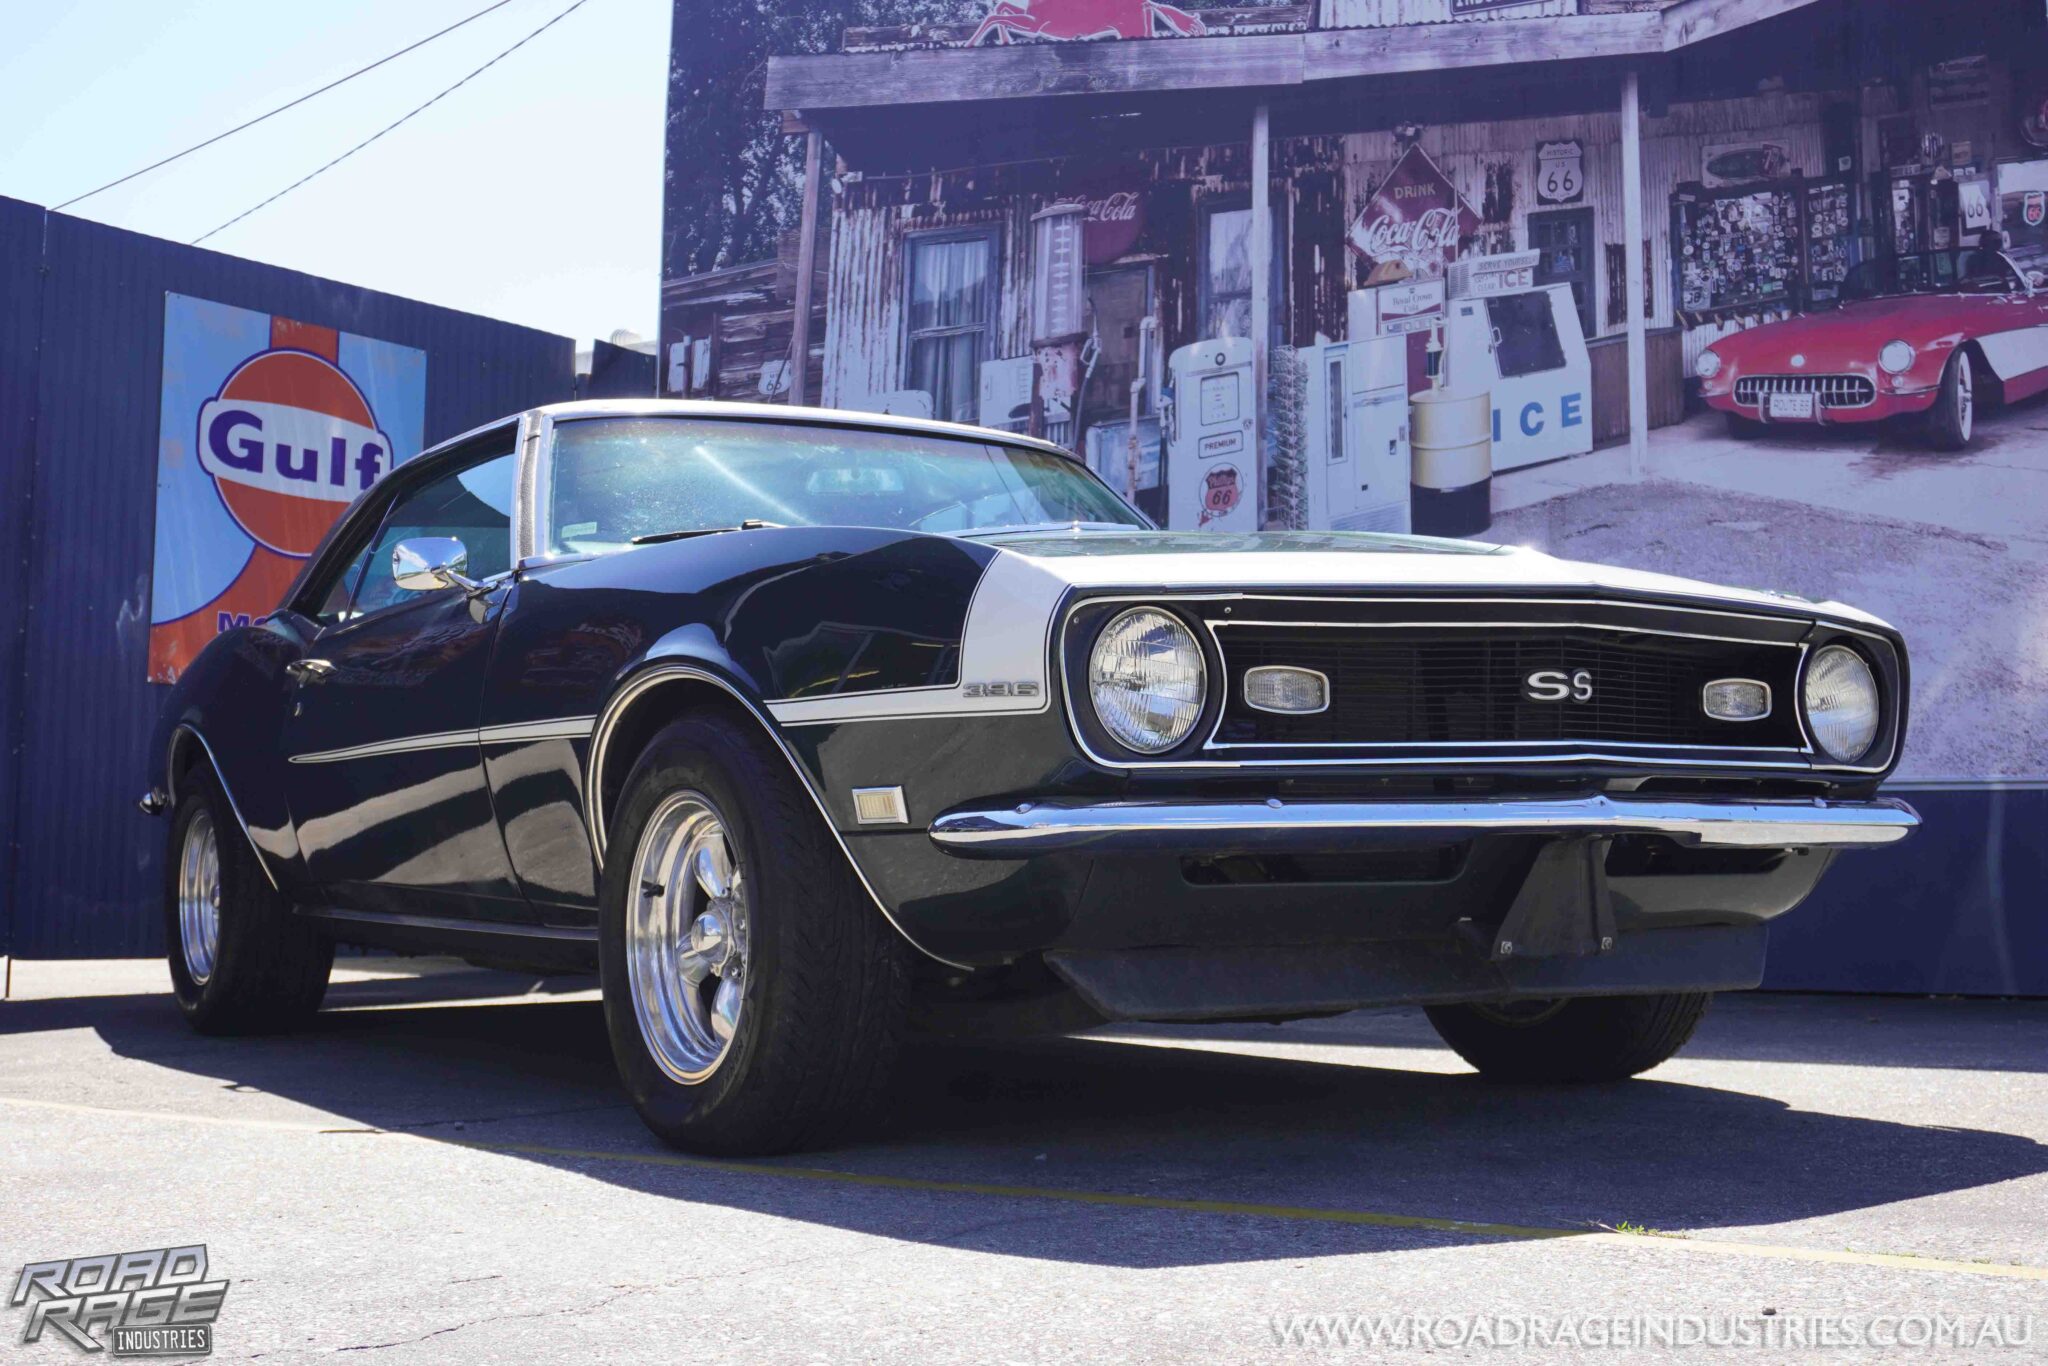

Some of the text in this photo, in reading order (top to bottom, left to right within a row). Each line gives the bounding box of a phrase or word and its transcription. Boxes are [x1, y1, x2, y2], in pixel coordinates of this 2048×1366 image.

[1393, 183, 1436, 199] DRINK
[1548, 170, 1574, 193] 66
[1370, 207, 1463, 256] Coca-Cola
[1479, 260, 1501, 272] SERVE
[1501, 268, 1529, 288] ICE
[1492, 392, 1583, 442] ICE
[208, 410, 383, 490] Gulf
[1204, 438, 1237, 451] PREMIUM
[1212, 489, 1232, 505] 66
[963, 682, 1039, 697] 396
[1527, 671, 1593, 700] SS
